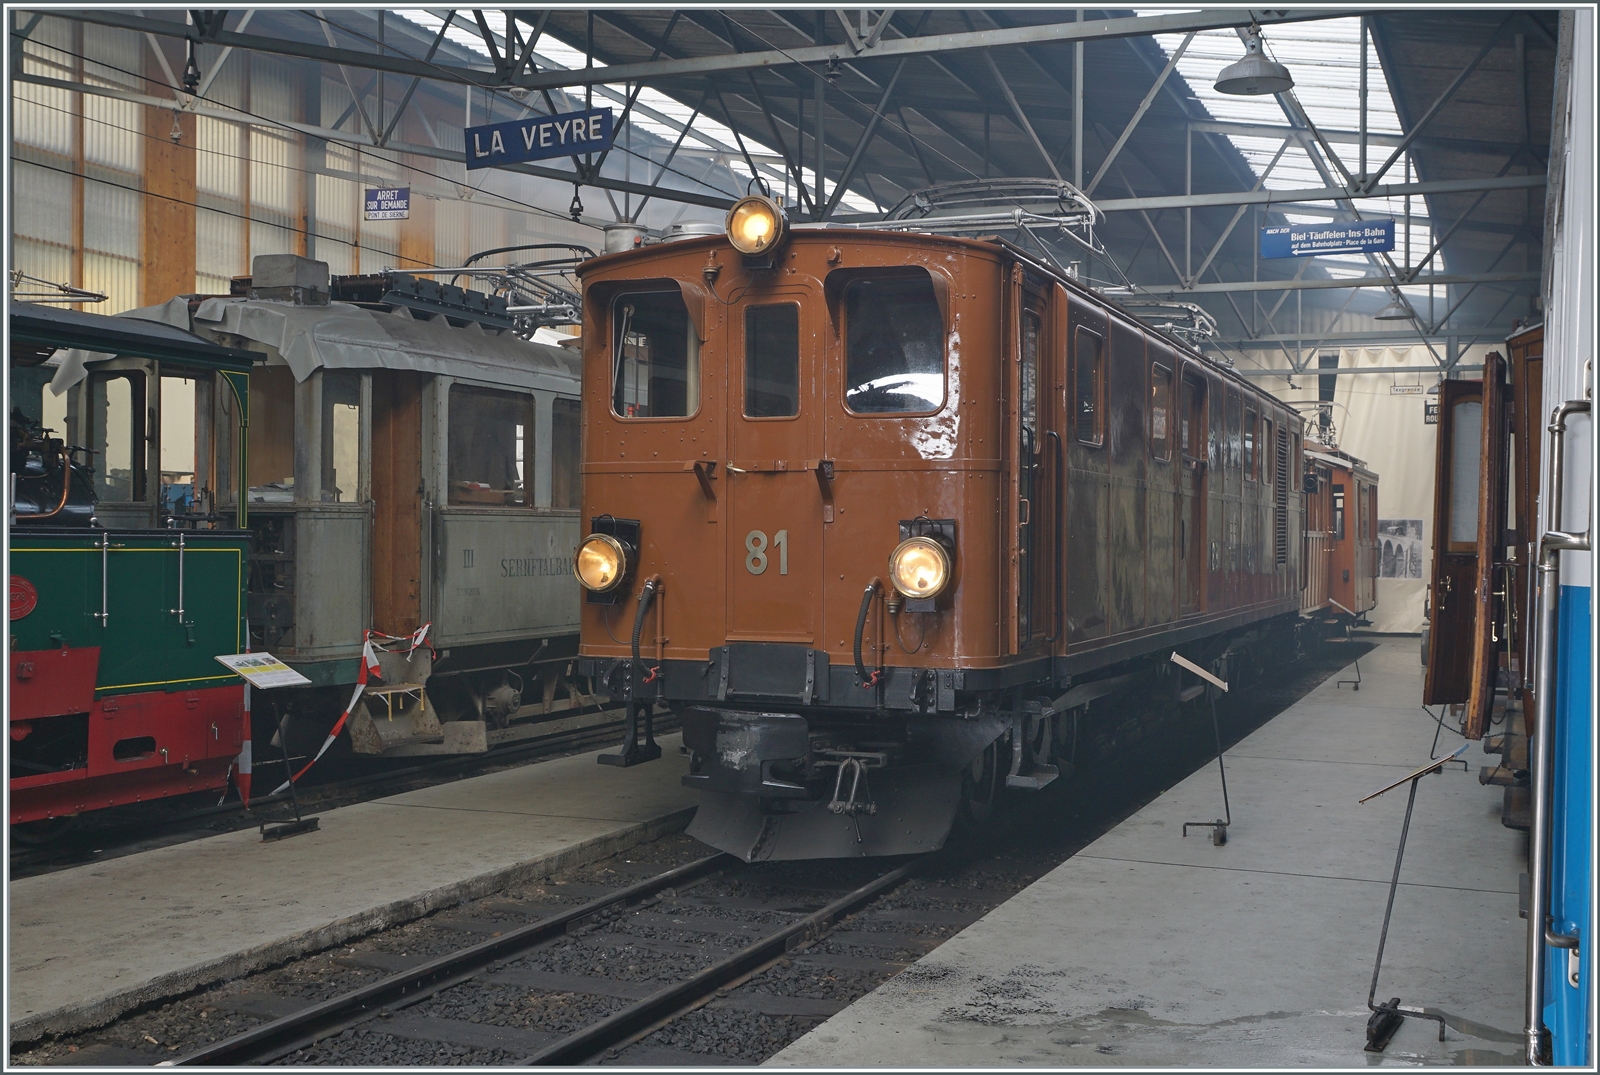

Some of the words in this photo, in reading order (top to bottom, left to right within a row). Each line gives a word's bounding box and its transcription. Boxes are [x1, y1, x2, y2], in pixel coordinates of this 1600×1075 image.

[474, 130, 505, 157] LA
[521, 115, 603, 150] VEYRE
[377, 190, 398, 200] ARRET
[367, 201, 378, 209] SUR
[381, 200, 407, 209] DEMANDE
[368, 211, 380, 219] PONT
[745, 529, 788, 575] 81
[501, 558, 575, 577] SERNFTALBAH
